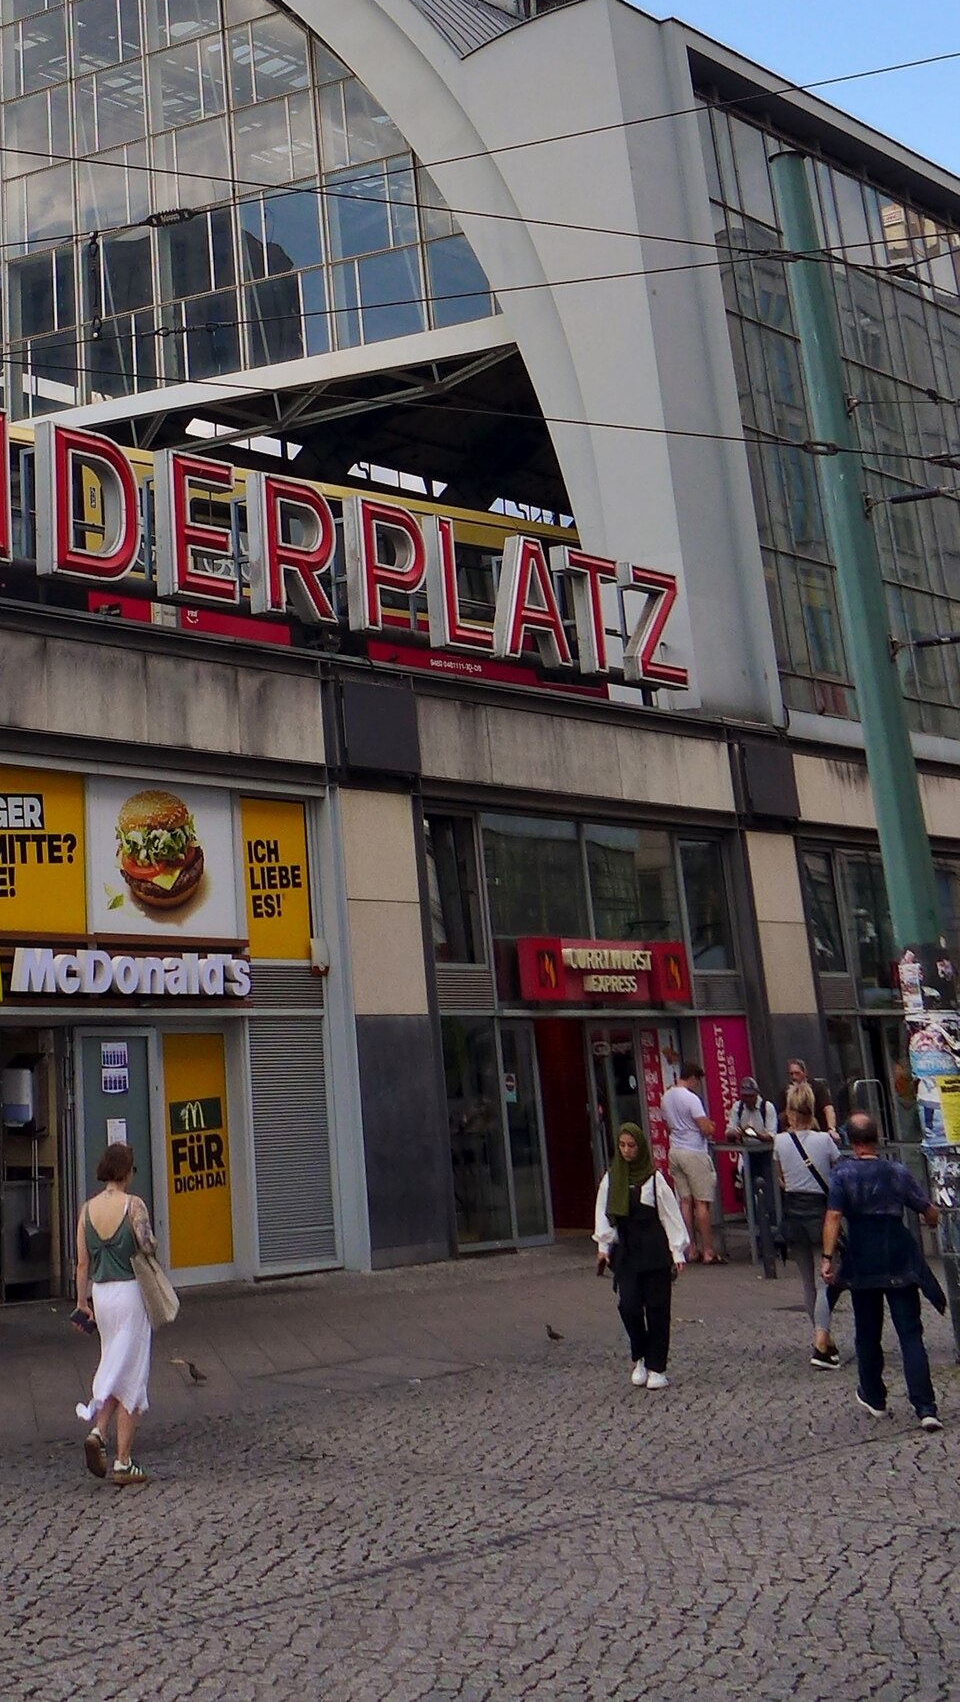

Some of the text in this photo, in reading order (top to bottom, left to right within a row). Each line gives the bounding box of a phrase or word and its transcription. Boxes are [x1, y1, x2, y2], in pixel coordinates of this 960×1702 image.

[247, 840, 280, 864] ICH
[249, 865, 302, 890] LIEBE
[252, 894, 282, 919] ES!
[10, 947, 252, 996] McDonald's
[563, 948, 652, 971] CURRYWURST
[585, 974, 638, 993] EXPRESS
[174, 1170, 226, 1194] DICH DA!
